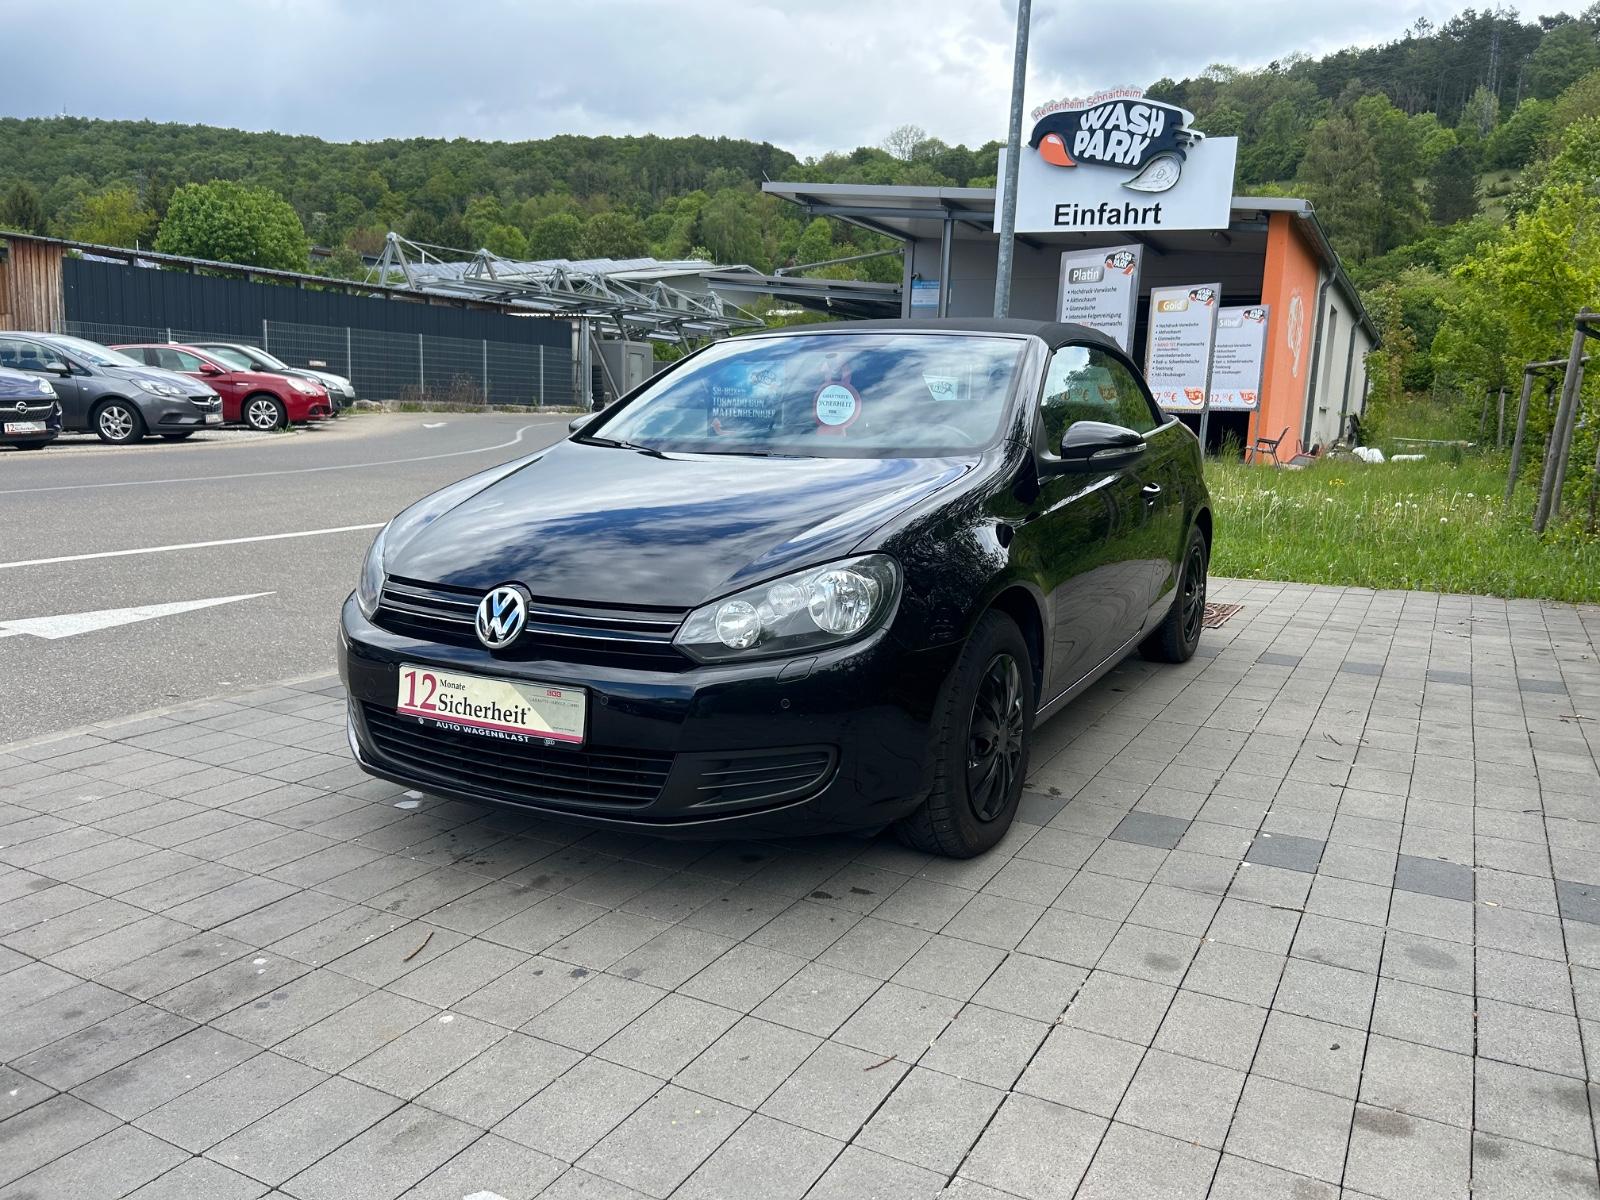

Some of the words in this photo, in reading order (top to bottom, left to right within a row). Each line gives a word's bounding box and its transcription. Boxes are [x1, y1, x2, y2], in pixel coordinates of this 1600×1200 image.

[1033, 99, 1085, 120] Heidenheim
[1087, 88, 1142, 107] Schnaitheim
[1079, 102, 1165, 138] WASH
[1073, 129, 1151, 166] PARK
[1053, 202, 1162, 226] Einfahrt
[1072, 268, 1099, 281] Platin
[404, 671, 437, 711] 12
[439, 679, 466, 691] Monate
[436, 721, 461, 732] AUTO
[463, 725, 529, 743] WAGENBLAST
